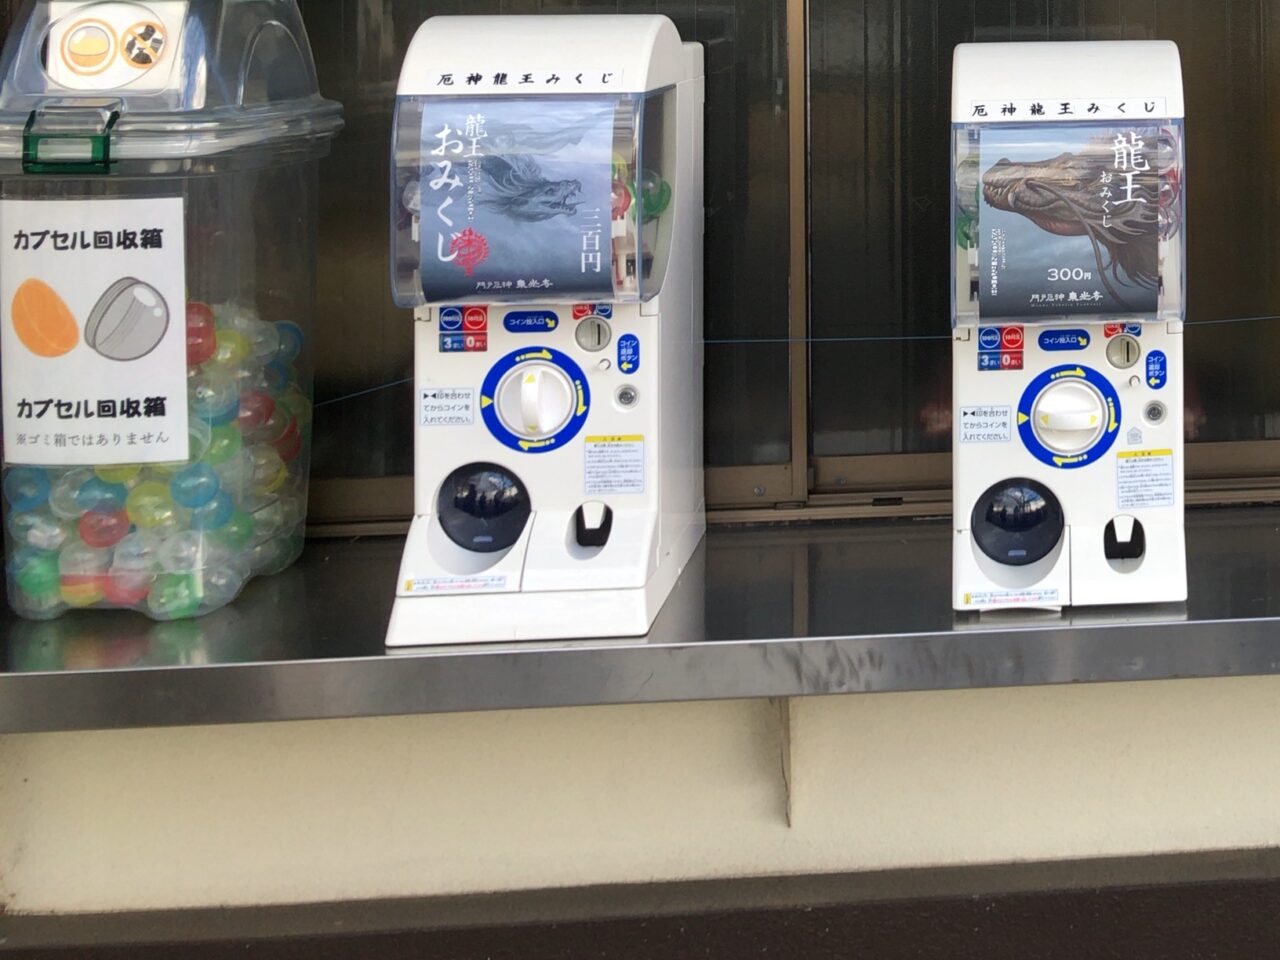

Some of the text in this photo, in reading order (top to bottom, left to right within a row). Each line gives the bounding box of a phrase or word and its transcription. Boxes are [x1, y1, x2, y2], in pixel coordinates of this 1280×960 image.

[437, 72, 614, 86] 厄神龍王みくじ
[971, 101, 1156, 117] 厄神龍王みくじ
[464, 113, 489, 158] 龍王
[1110, 131, 1151, 206] 龍王
[429, 123, 464, 262] おみくじ
[1100, 170, 1113, 228] おみくじ
[13, 227, 164, 251] カプセル回収箱
[1047, 267, 1092, 281] 300円
[17, 396, 167, 420] カプセル回収箱
